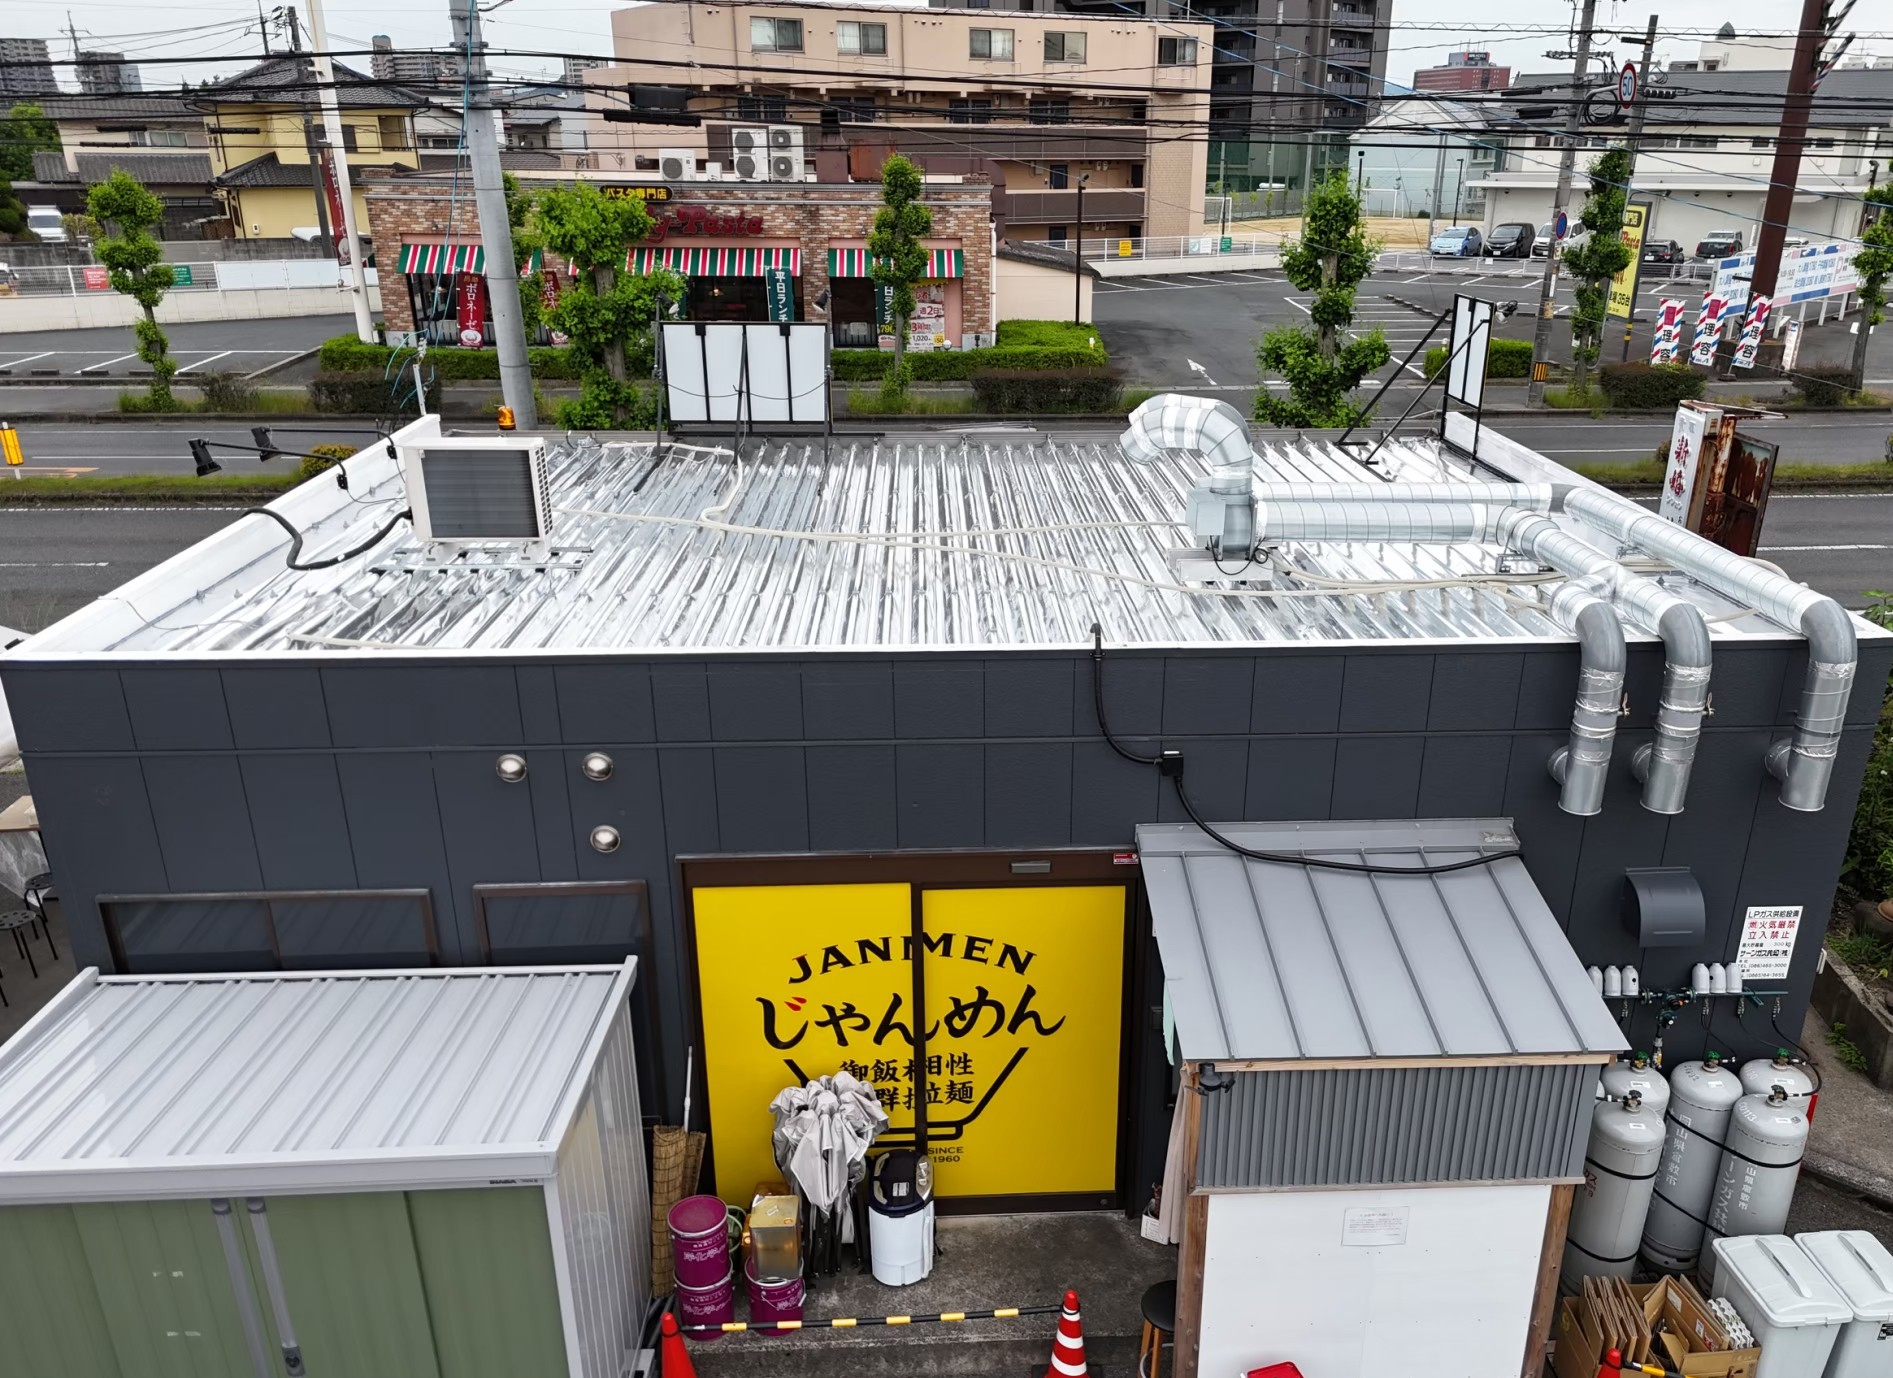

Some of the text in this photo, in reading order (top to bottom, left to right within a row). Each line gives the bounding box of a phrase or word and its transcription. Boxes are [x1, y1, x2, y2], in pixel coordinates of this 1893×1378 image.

[1623, 76, 1633, 96] 50
[465, 283, 478, 330] ボロネーゼ
[775, 271, 788, 323] 平日ランチ
[1660, 329, 1673, 362] 理容
[1700, 322, 1716, 356] 理容
[1742, 325, 1760, 359] 理容
[1747, 931, 1790, 940] 立入禁止
[788, 932, 1037, 984] JANMEN
[755, 984, 1066, 1050] じゃんめん
[874, 1080, 975, 1112] 群拉麺
[927, 1146, 964, 1155] SINCE
[933, 1155, 961, 1163] 1960
